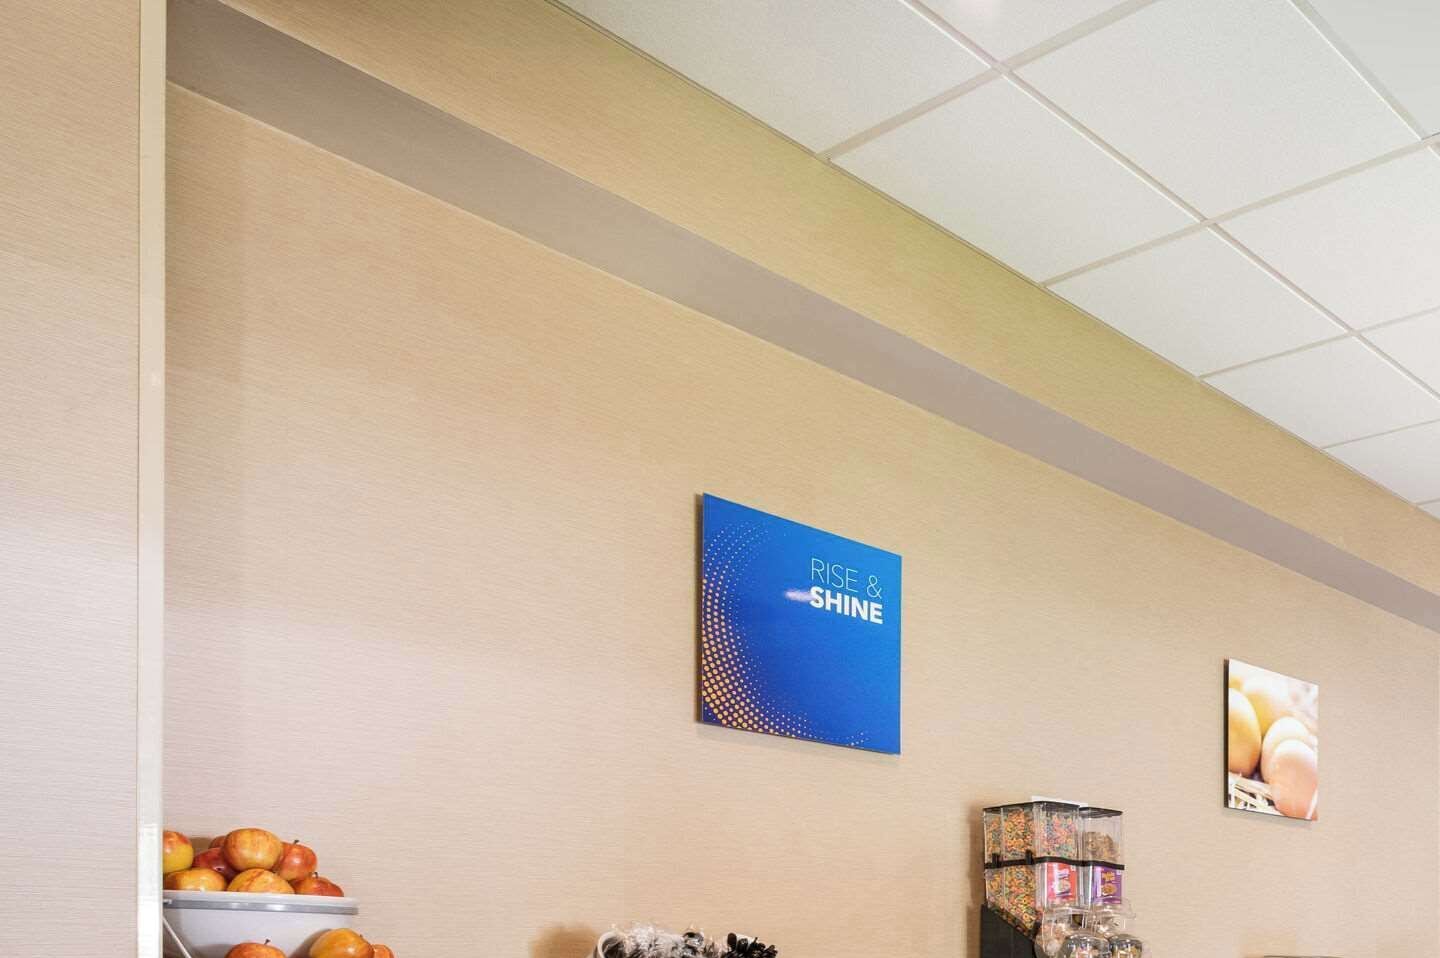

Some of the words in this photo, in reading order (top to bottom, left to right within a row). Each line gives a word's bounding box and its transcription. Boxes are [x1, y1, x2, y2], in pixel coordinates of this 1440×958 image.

[811, 557, 858, 593] RISE
[866, 575, 882, 599] &
[810, 586, 883, 625] SHINE
